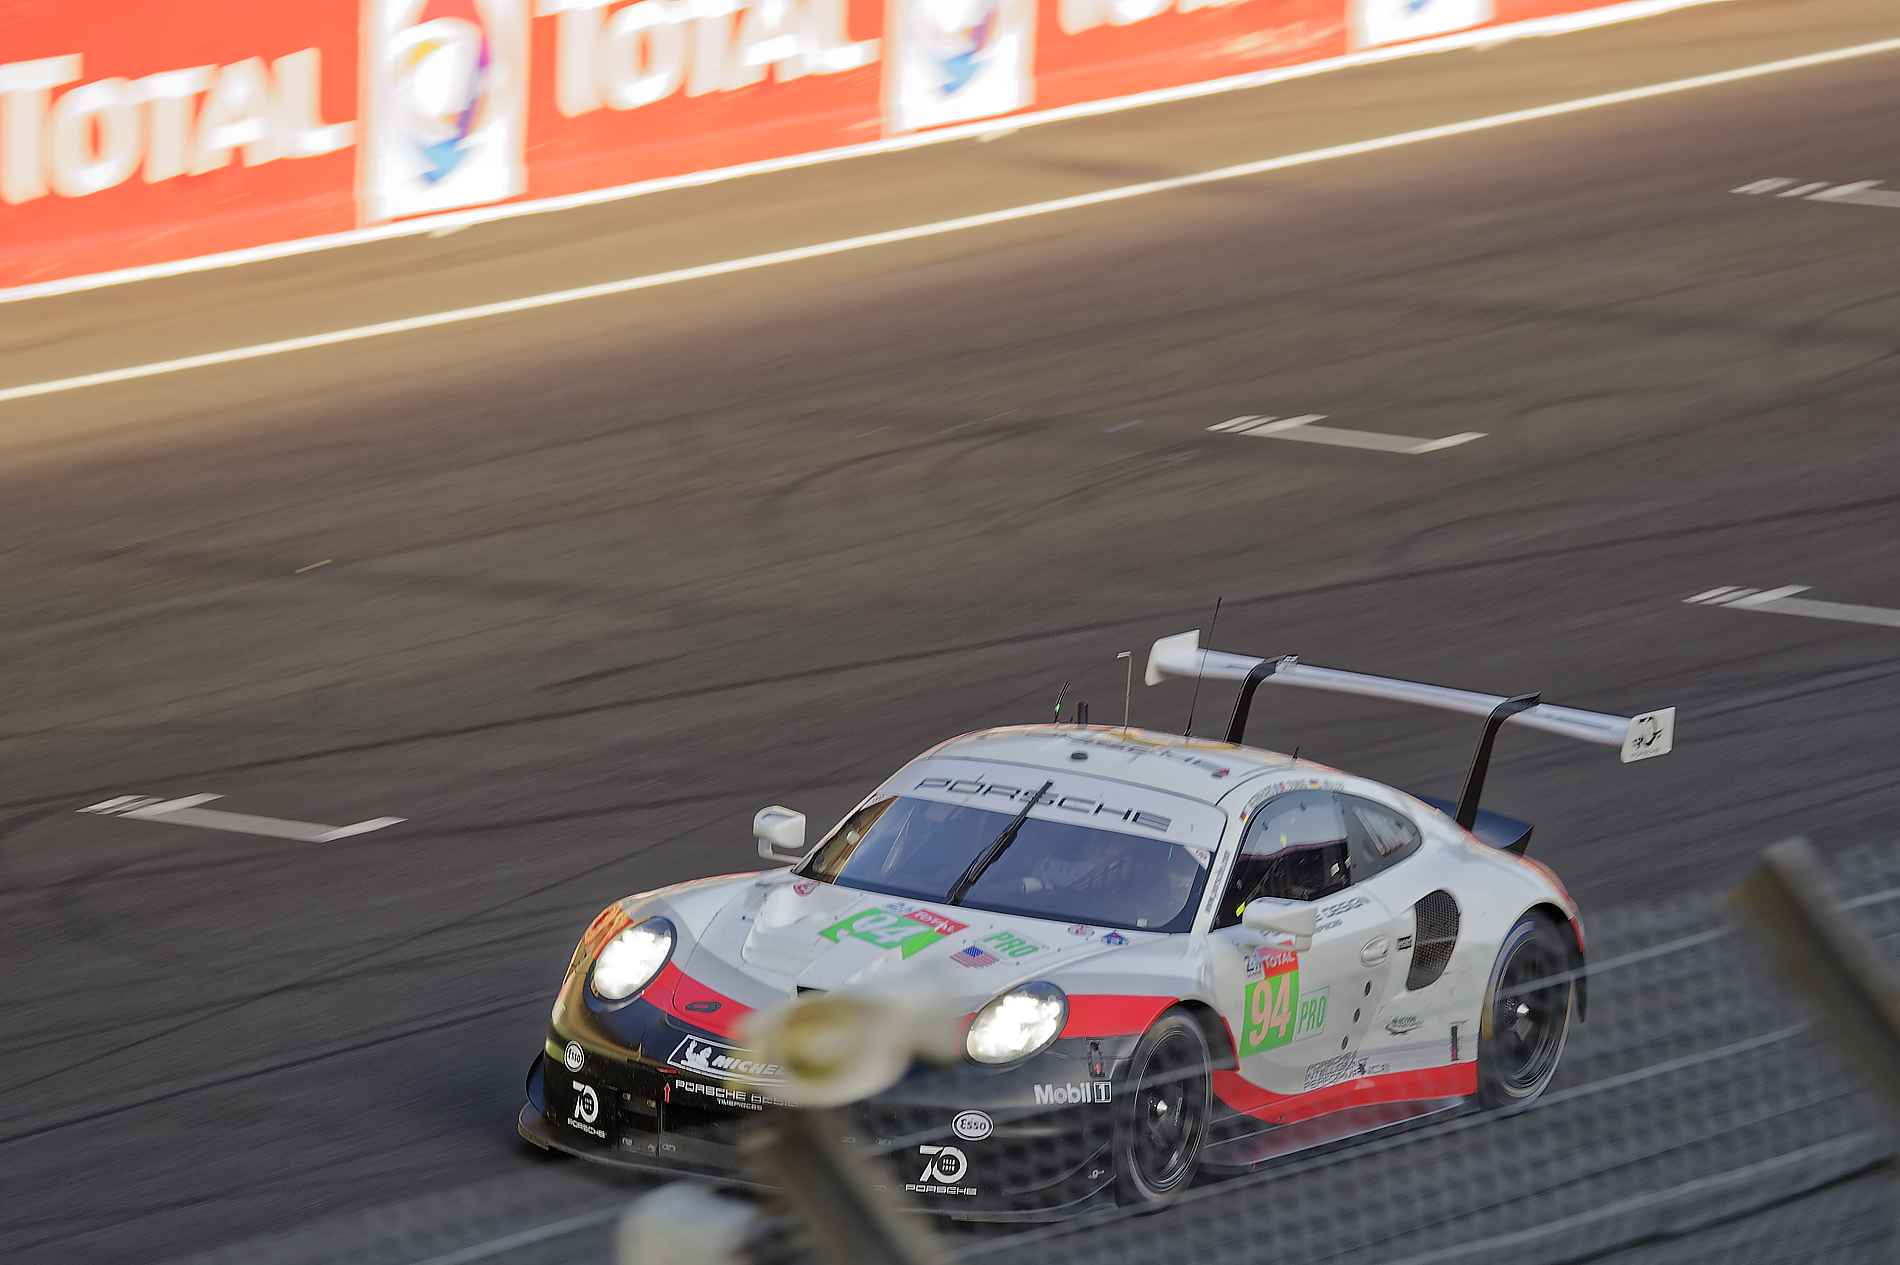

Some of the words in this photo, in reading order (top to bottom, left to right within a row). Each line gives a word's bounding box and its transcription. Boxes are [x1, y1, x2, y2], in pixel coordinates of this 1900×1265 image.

[914, 776, 1173, 833] PORSCHE
[982, 930, 1041, 958] PRO
[1248, 972, 1291, 1047] 94
[1297, 995, 1328, 1034] PRO
[572, 1080, 599, 1124] 70
[675, 1079, 747, 1102] PORSCHE
[1034, 1083, 1092, 1105] Mobil
[919, 1145, 968, 1184] 70
[904, 1183, 978, 1196] PORSCHE
